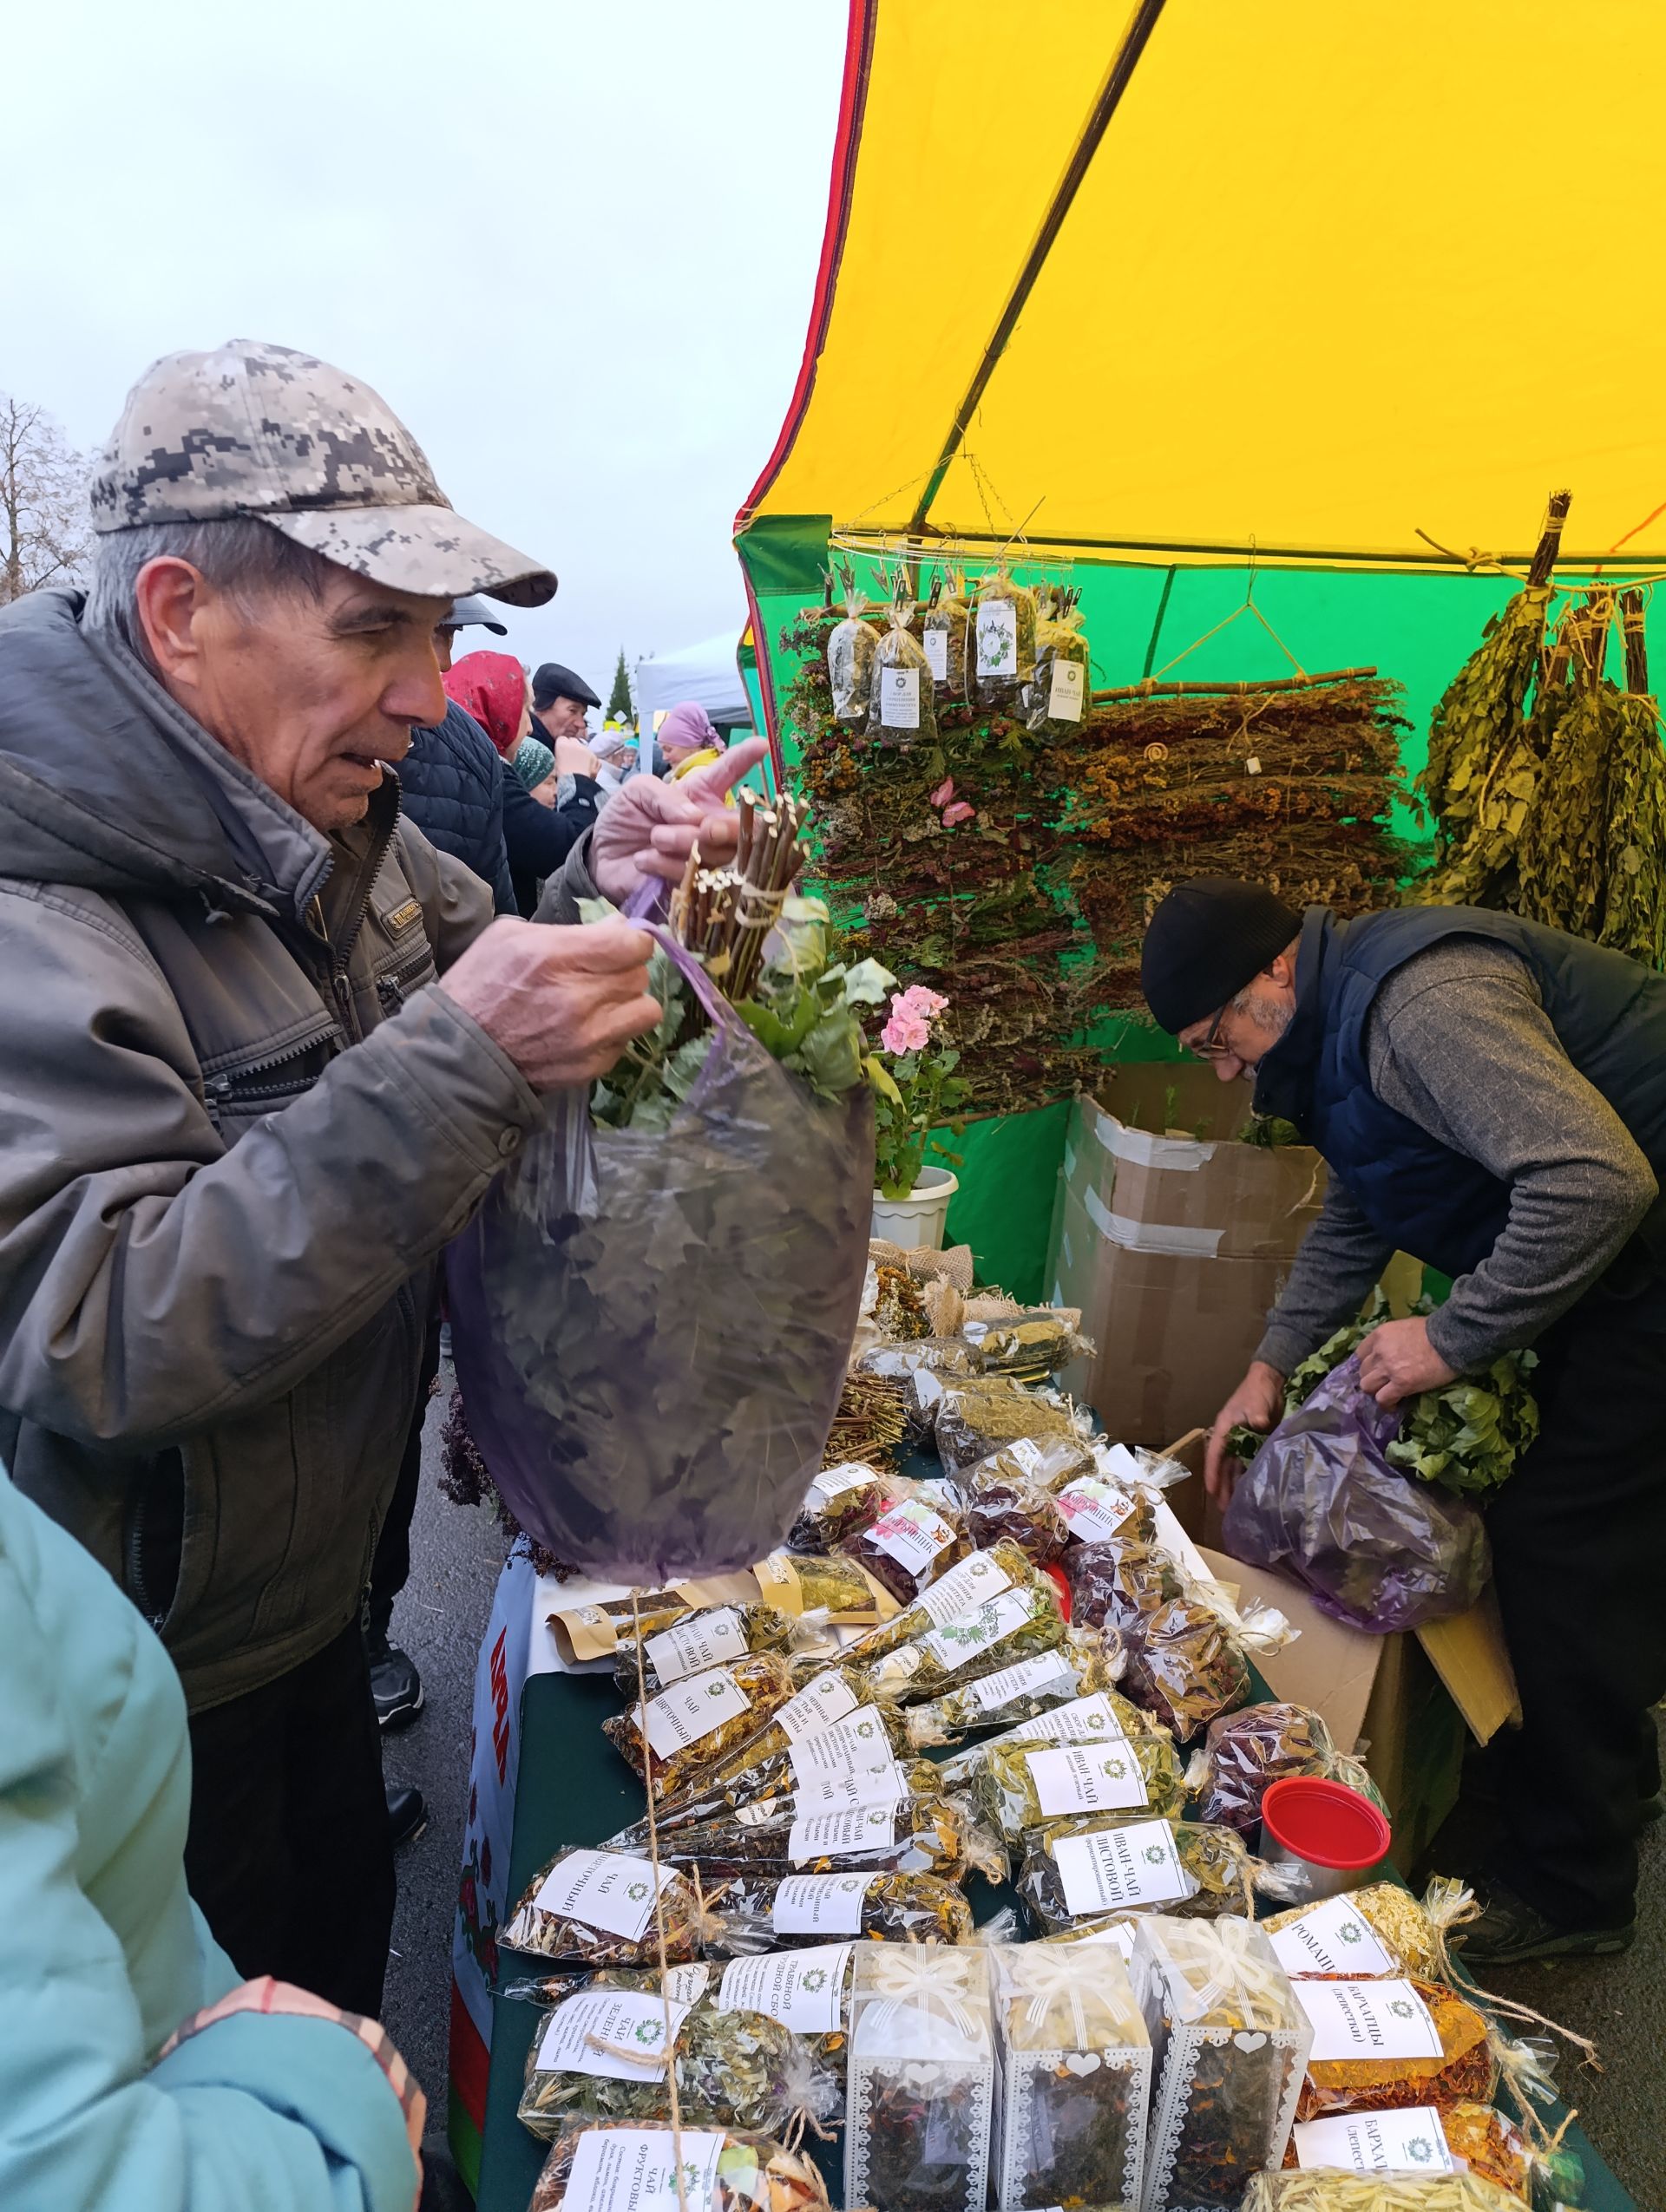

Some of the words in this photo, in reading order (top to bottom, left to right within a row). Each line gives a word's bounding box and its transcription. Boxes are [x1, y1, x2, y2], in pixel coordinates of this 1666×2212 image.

[656, 1696, 692, 1744] ЦВЕТОЧНЫЙ
[685, 1696, 700, 1714] ЧАЙ
[1071, 1712, 1082, 1727] СБОР
[1072, 1751, 1099, 1803] ИВАН-ЧАЙ
[562, 1854, 611, 1912] ЦВЕТОЧНЫЙ
[598, 1874, 618, 1894] ЧАЙ
[1096, 1836, 1125, 1901] ЛИСТОВОЙ
[1113, 1833, 1141, 1897] ИВАН-ЧАЙ
[1292, 1923, 1337, 1972] РОМАШ
[771, 1993, 779, 2017] СБО
[783, 1960, 798, 2010] ТРАВЯНОЙ
[1332, 1987, 1366, 2043] (лепестки)
[1347, 1986, 1384, 2046] БАРХАТЦЫ
[596, 2139, 610, 2174] бергамот,
[1346, 2125, 1365, 2170] (лепест
[1364, 2119, 1388, 2169] БАРХАТ
[590, 2176, 600, 2202] яблоко,
[627, 2144, 649, 2212] ФРУКТОВЫ
[645, 2168, 658, 2194] ЧАЙ
